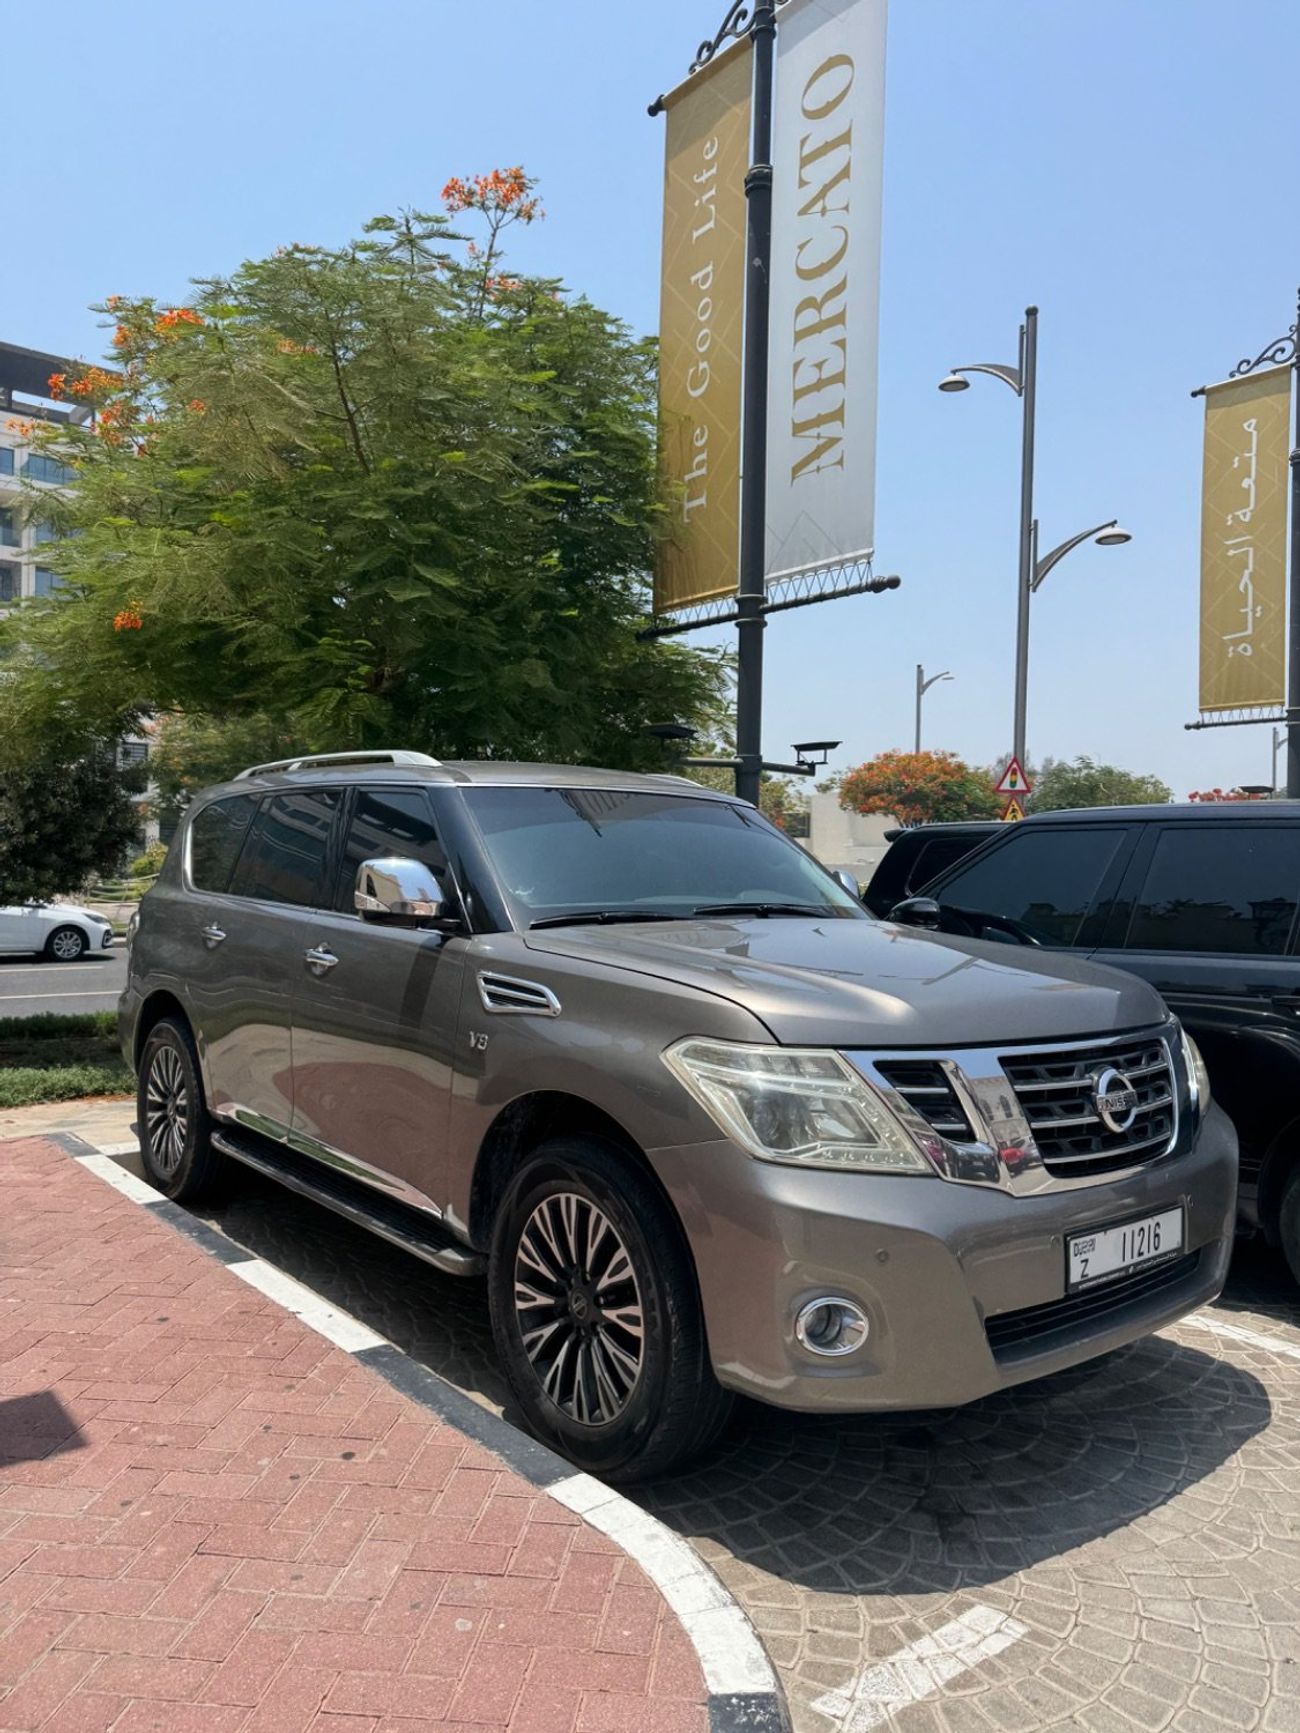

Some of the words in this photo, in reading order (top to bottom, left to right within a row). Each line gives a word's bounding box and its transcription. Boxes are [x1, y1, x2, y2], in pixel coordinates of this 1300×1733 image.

[692, 135, 719, 245] Life
[790, 53, 856, 488] MERCATO
[687, 260, 714, 399] Good
[682, 424, 709, 524] The
[1225, 418, 1258, 526] متعة
[1222, 535, 1262, 658] الحياة
[1080, 1258, 1090, 1279] Z
[1121, 1221, 1162, 1263] 11216
